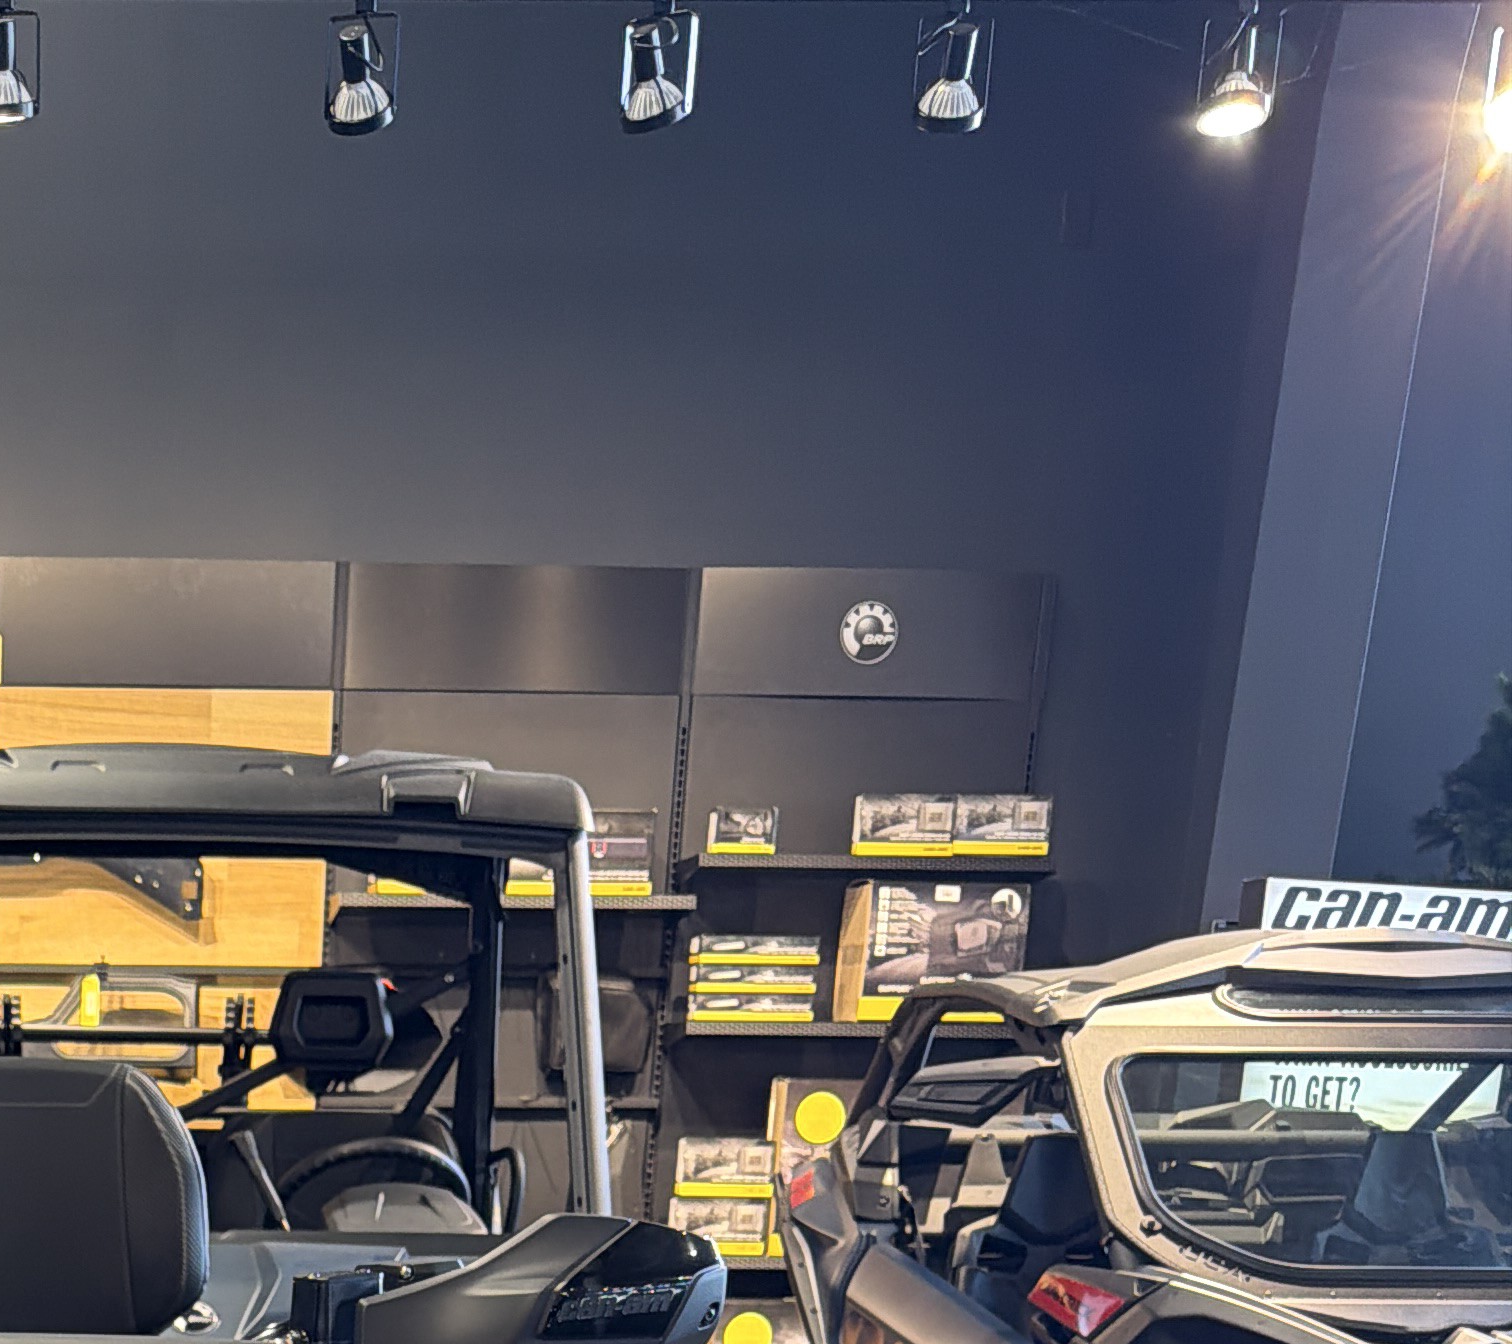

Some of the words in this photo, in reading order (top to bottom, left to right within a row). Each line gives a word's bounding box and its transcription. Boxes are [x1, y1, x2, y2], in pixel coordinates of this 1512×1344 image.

[861, 633, 895, 645] BRP
[1269, 1074, 1297, 1107] TO
[1305, 1075, 1361, 1112] GET?
[556, 1291, 675, 1323] can-am
